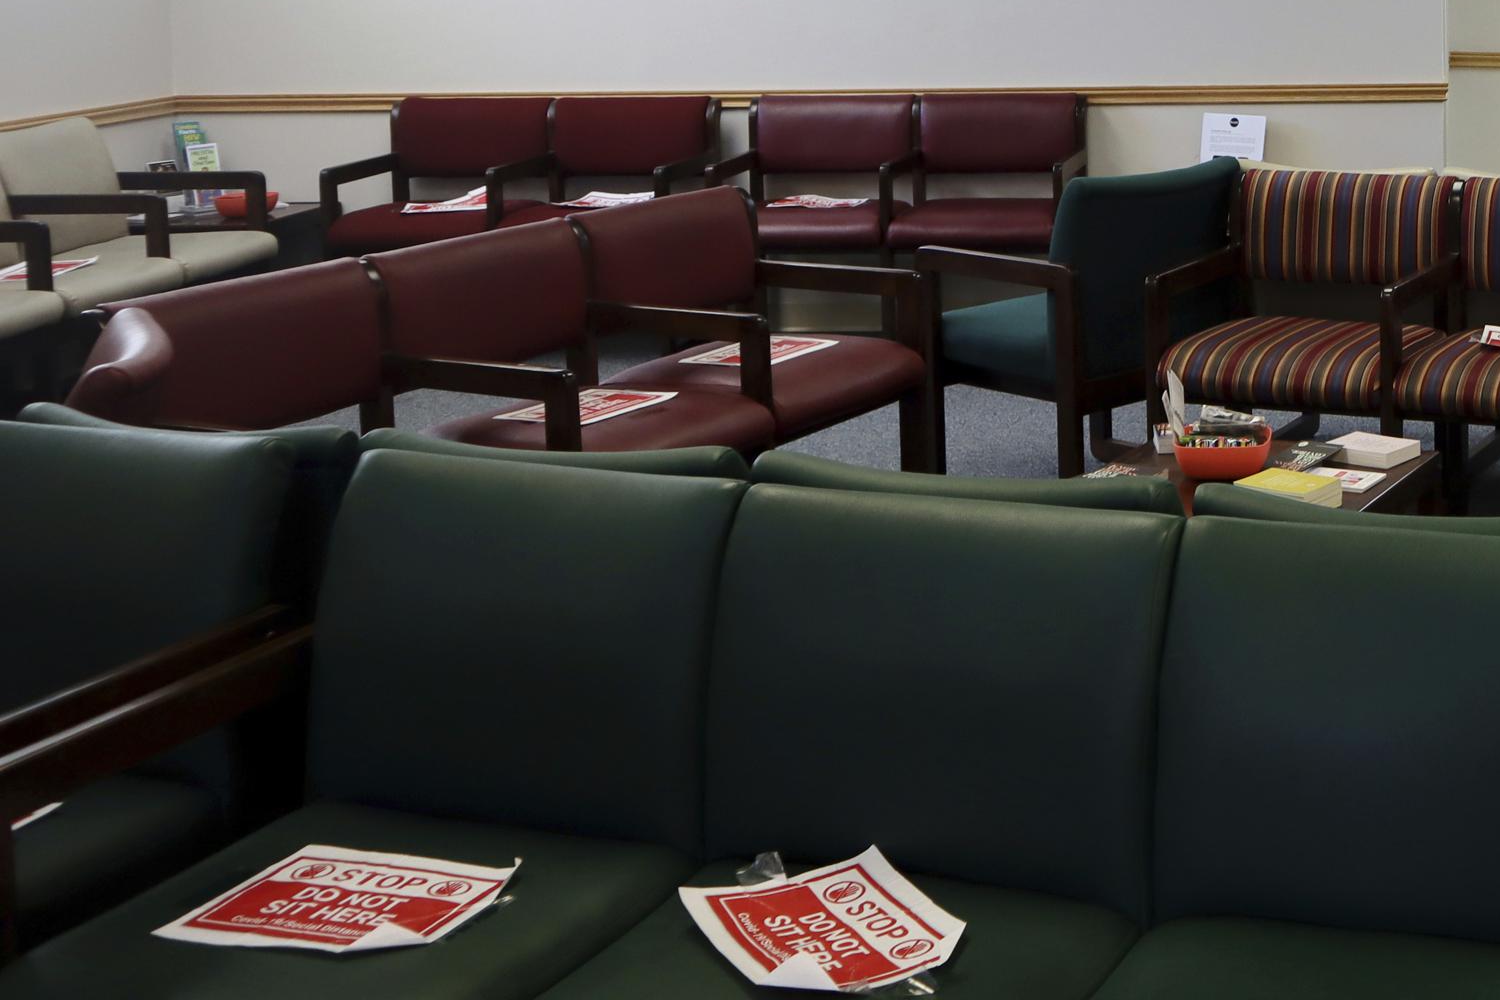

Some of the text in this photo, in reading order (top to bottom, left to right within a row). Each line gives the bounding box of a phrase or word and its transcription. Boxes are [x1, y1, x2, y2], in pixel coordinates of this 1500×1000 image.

[333, 869, 429, 890] STOP
[290, 886, 410, 912] DO NOT
[260, 899, 397, 927] SIT HERE
[763, 914, 806, 938] SIT
[845, 901, 909, 939] STOP
[798, 911, 872, 958] DO NOT
